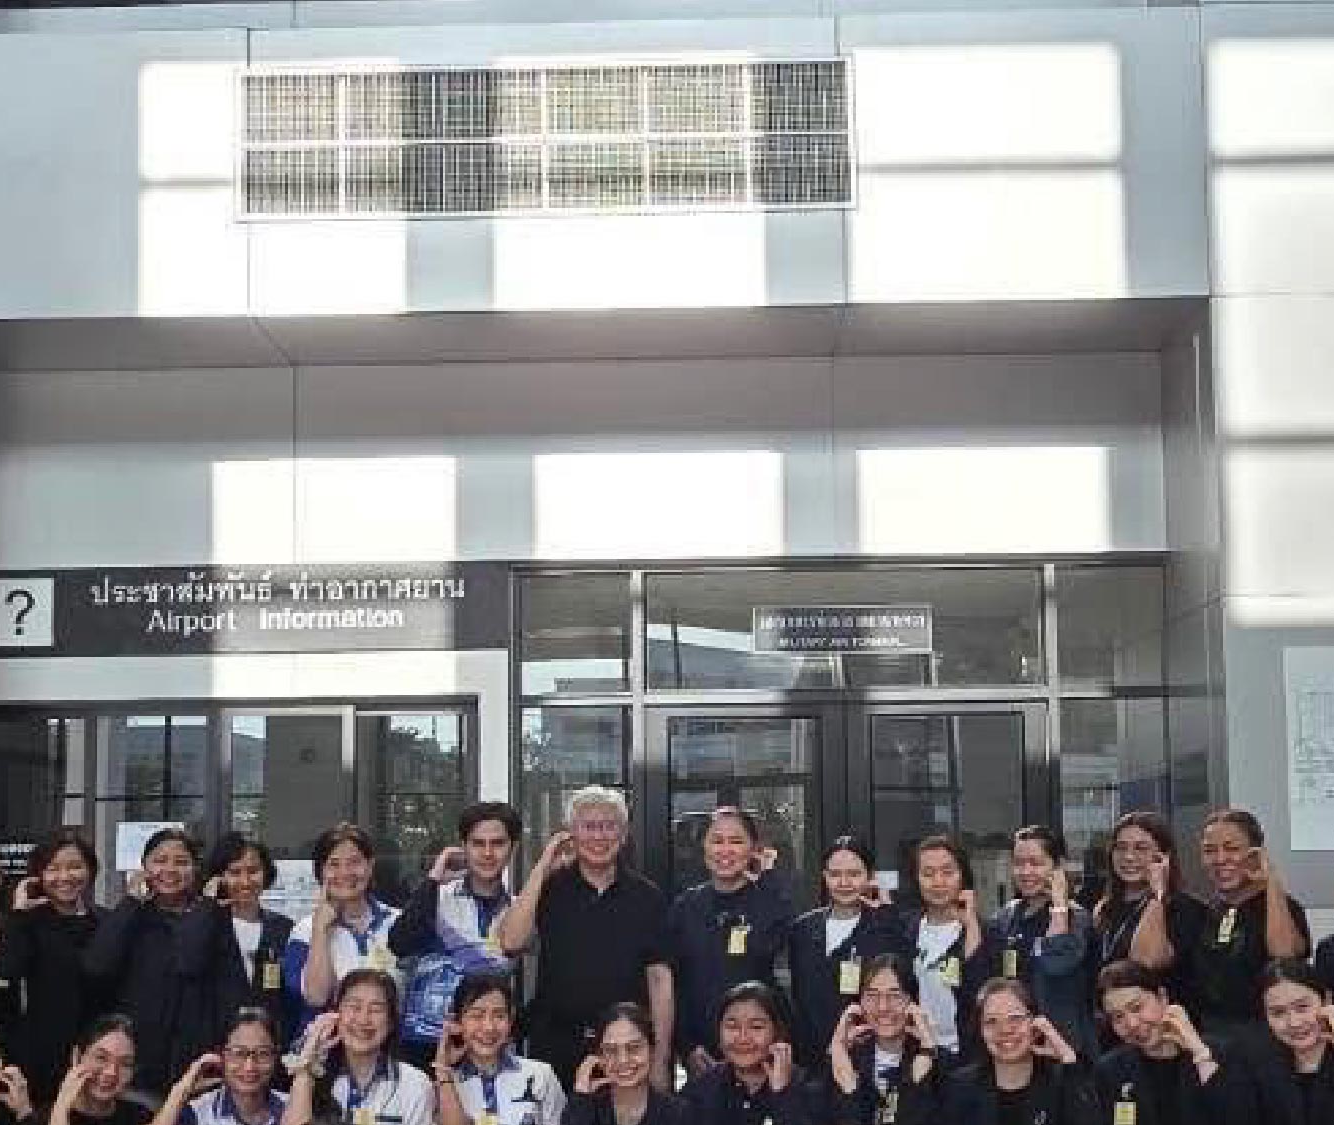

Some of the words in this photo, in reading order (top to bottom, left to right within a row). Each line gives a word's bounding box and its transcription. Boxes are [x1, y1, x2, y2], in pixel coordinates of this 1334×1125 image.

[89, 569, 273, 604] ประชาสัมพันธ์
[289, 570, 466, 600] ท่าอากาศยาน
[146, 609, 237, 637] Airport
[259, 606, 405, 631] Information
